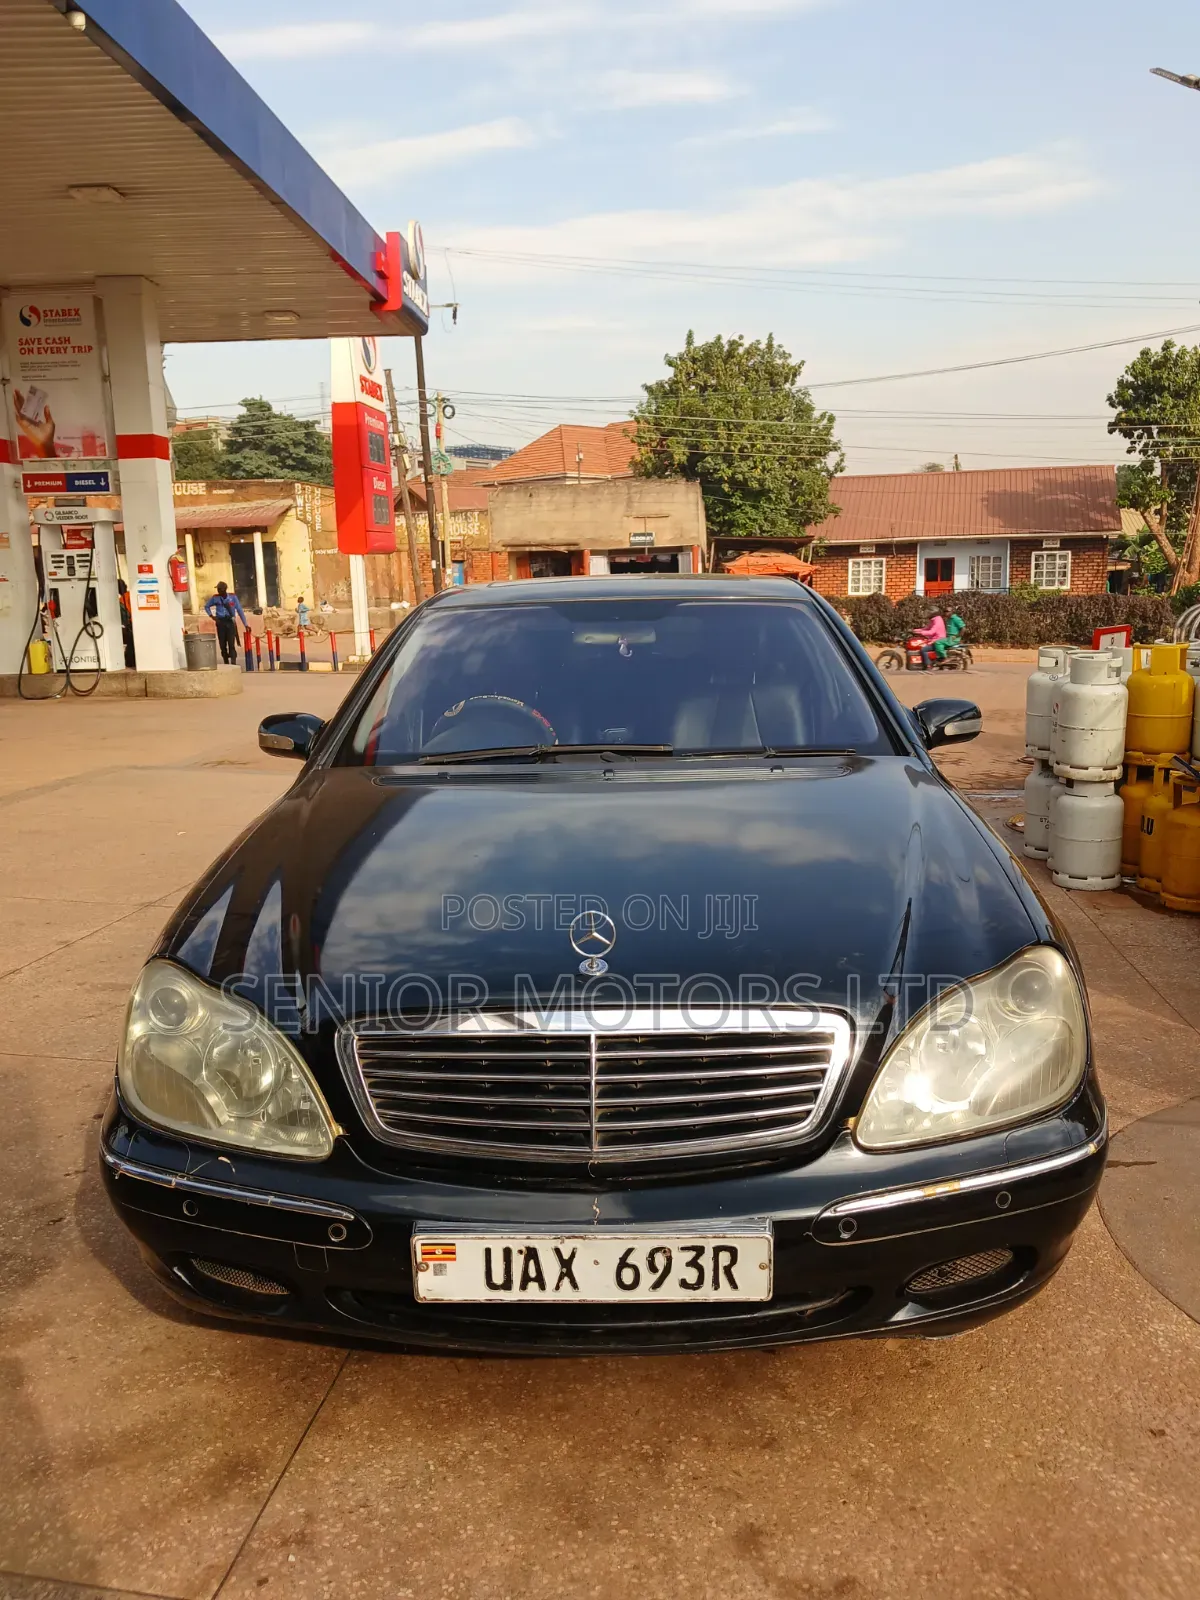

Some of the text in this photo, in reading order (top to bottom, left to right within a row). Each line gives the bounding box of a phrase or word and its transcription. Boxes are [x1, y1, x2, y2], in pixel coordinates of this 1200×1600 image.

[43, 308, 81, 318] STABEX
[18, 336, 71, 346] SAVE CASH
[19, 345, 93, 356] ON EVERY TRIP
[364, 412, 385, 431] Premium
[372, 476, 387, 491] Diesel
[484, 1245, 739, 1292] UAX 693R
